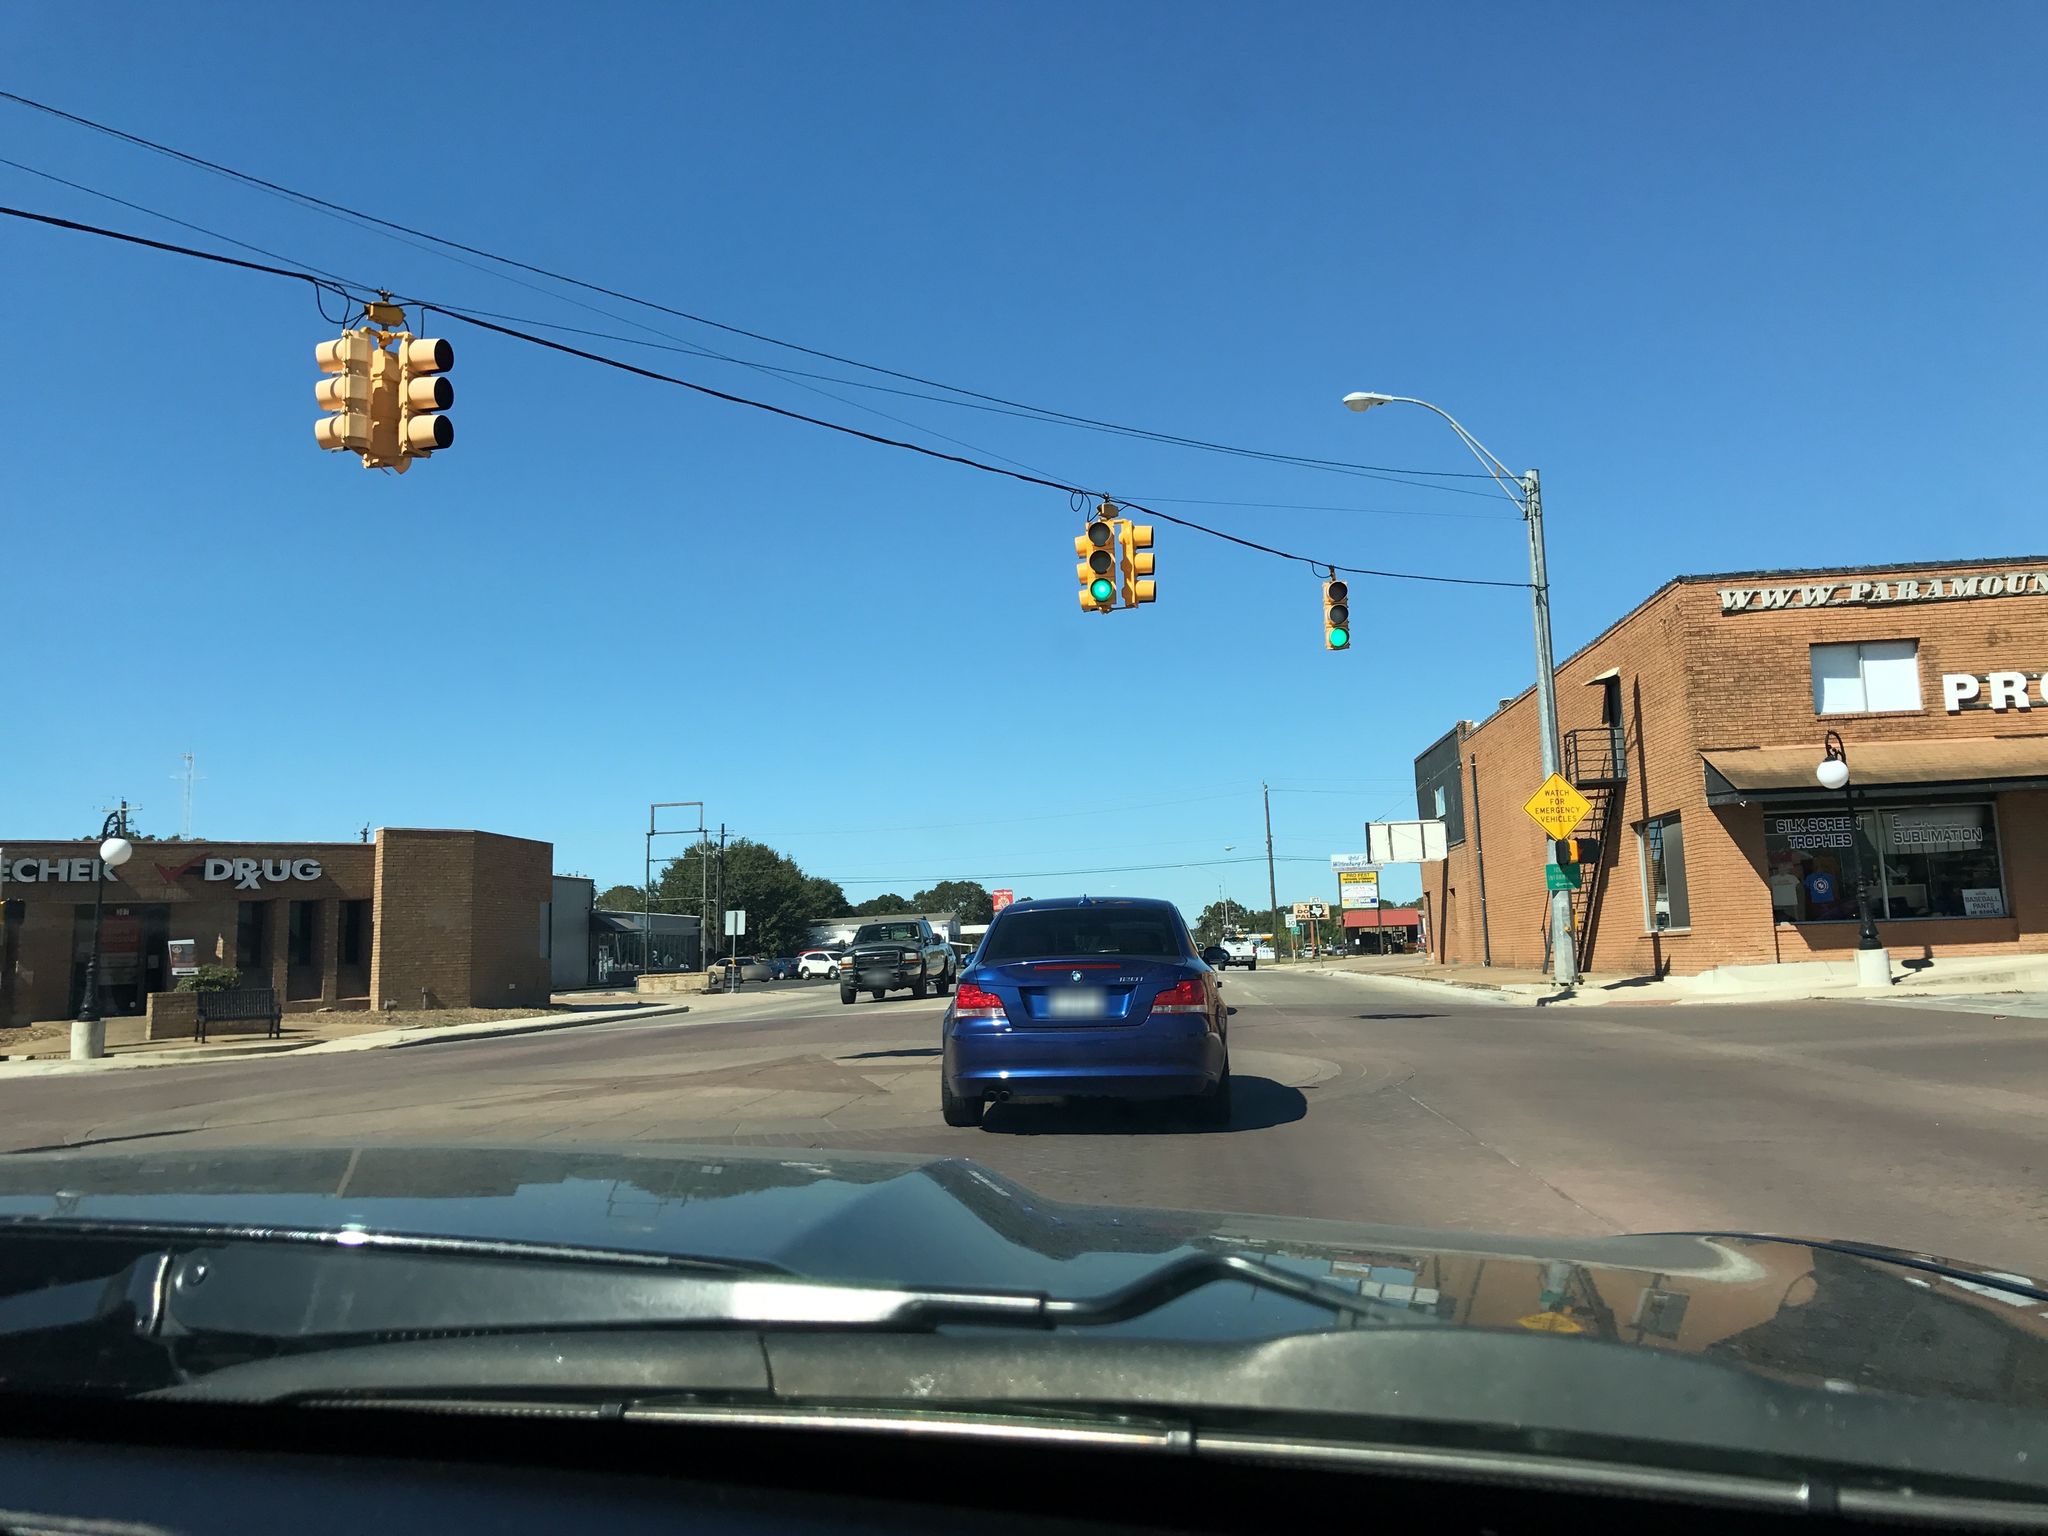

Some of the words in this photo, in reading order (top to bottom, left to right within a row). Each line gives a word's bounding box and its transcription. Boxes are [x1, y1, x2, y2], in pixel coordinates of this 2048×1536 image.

[1942, 671, 2048, 711] PR
[1788, 833, 1853, 849] TROPHIES
[1892, 826, 1983, 845] SUBLIMATION
